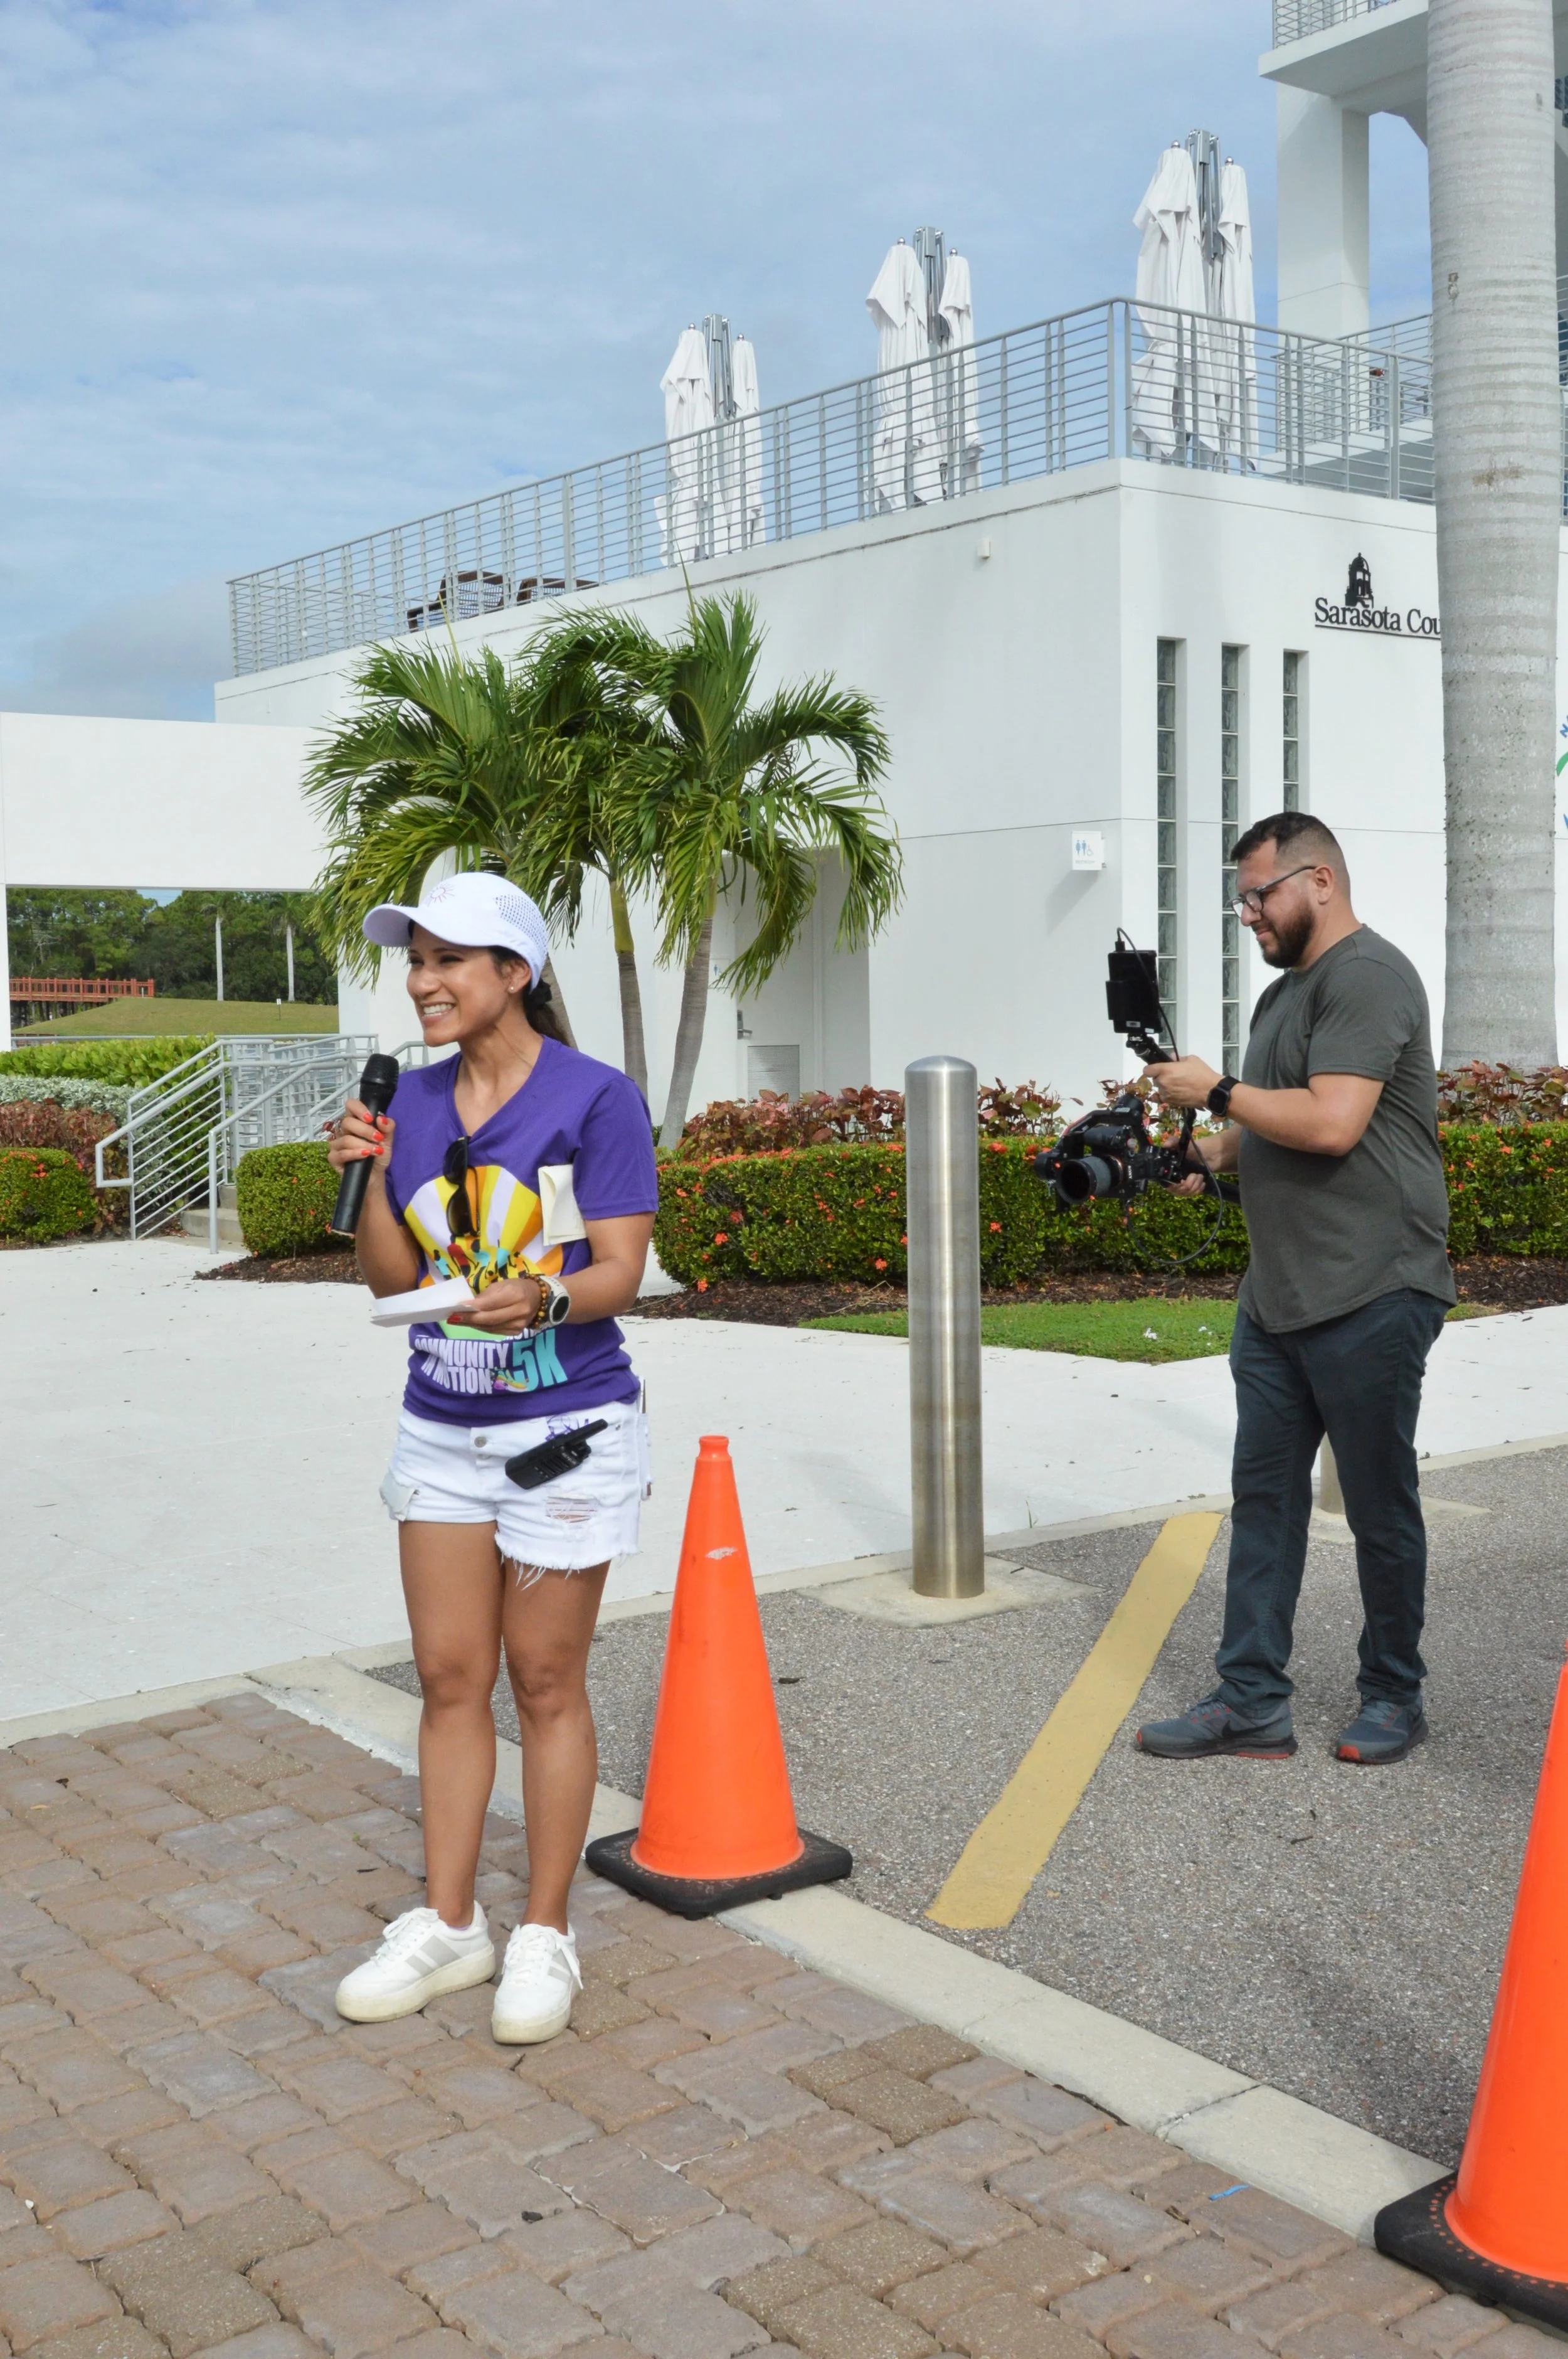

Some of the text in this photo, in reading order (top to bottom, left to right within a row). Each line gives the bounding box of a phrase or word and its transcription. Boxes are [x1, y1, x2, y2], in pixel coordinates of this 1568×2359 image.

[1315, 597, 1402, 632] Sarasota
[415, 1338, 509, 1369] COMMUNITY
[512, 1328, 568, 1392] 5K
[421, 1354, 493, 1395] IN MOTION
